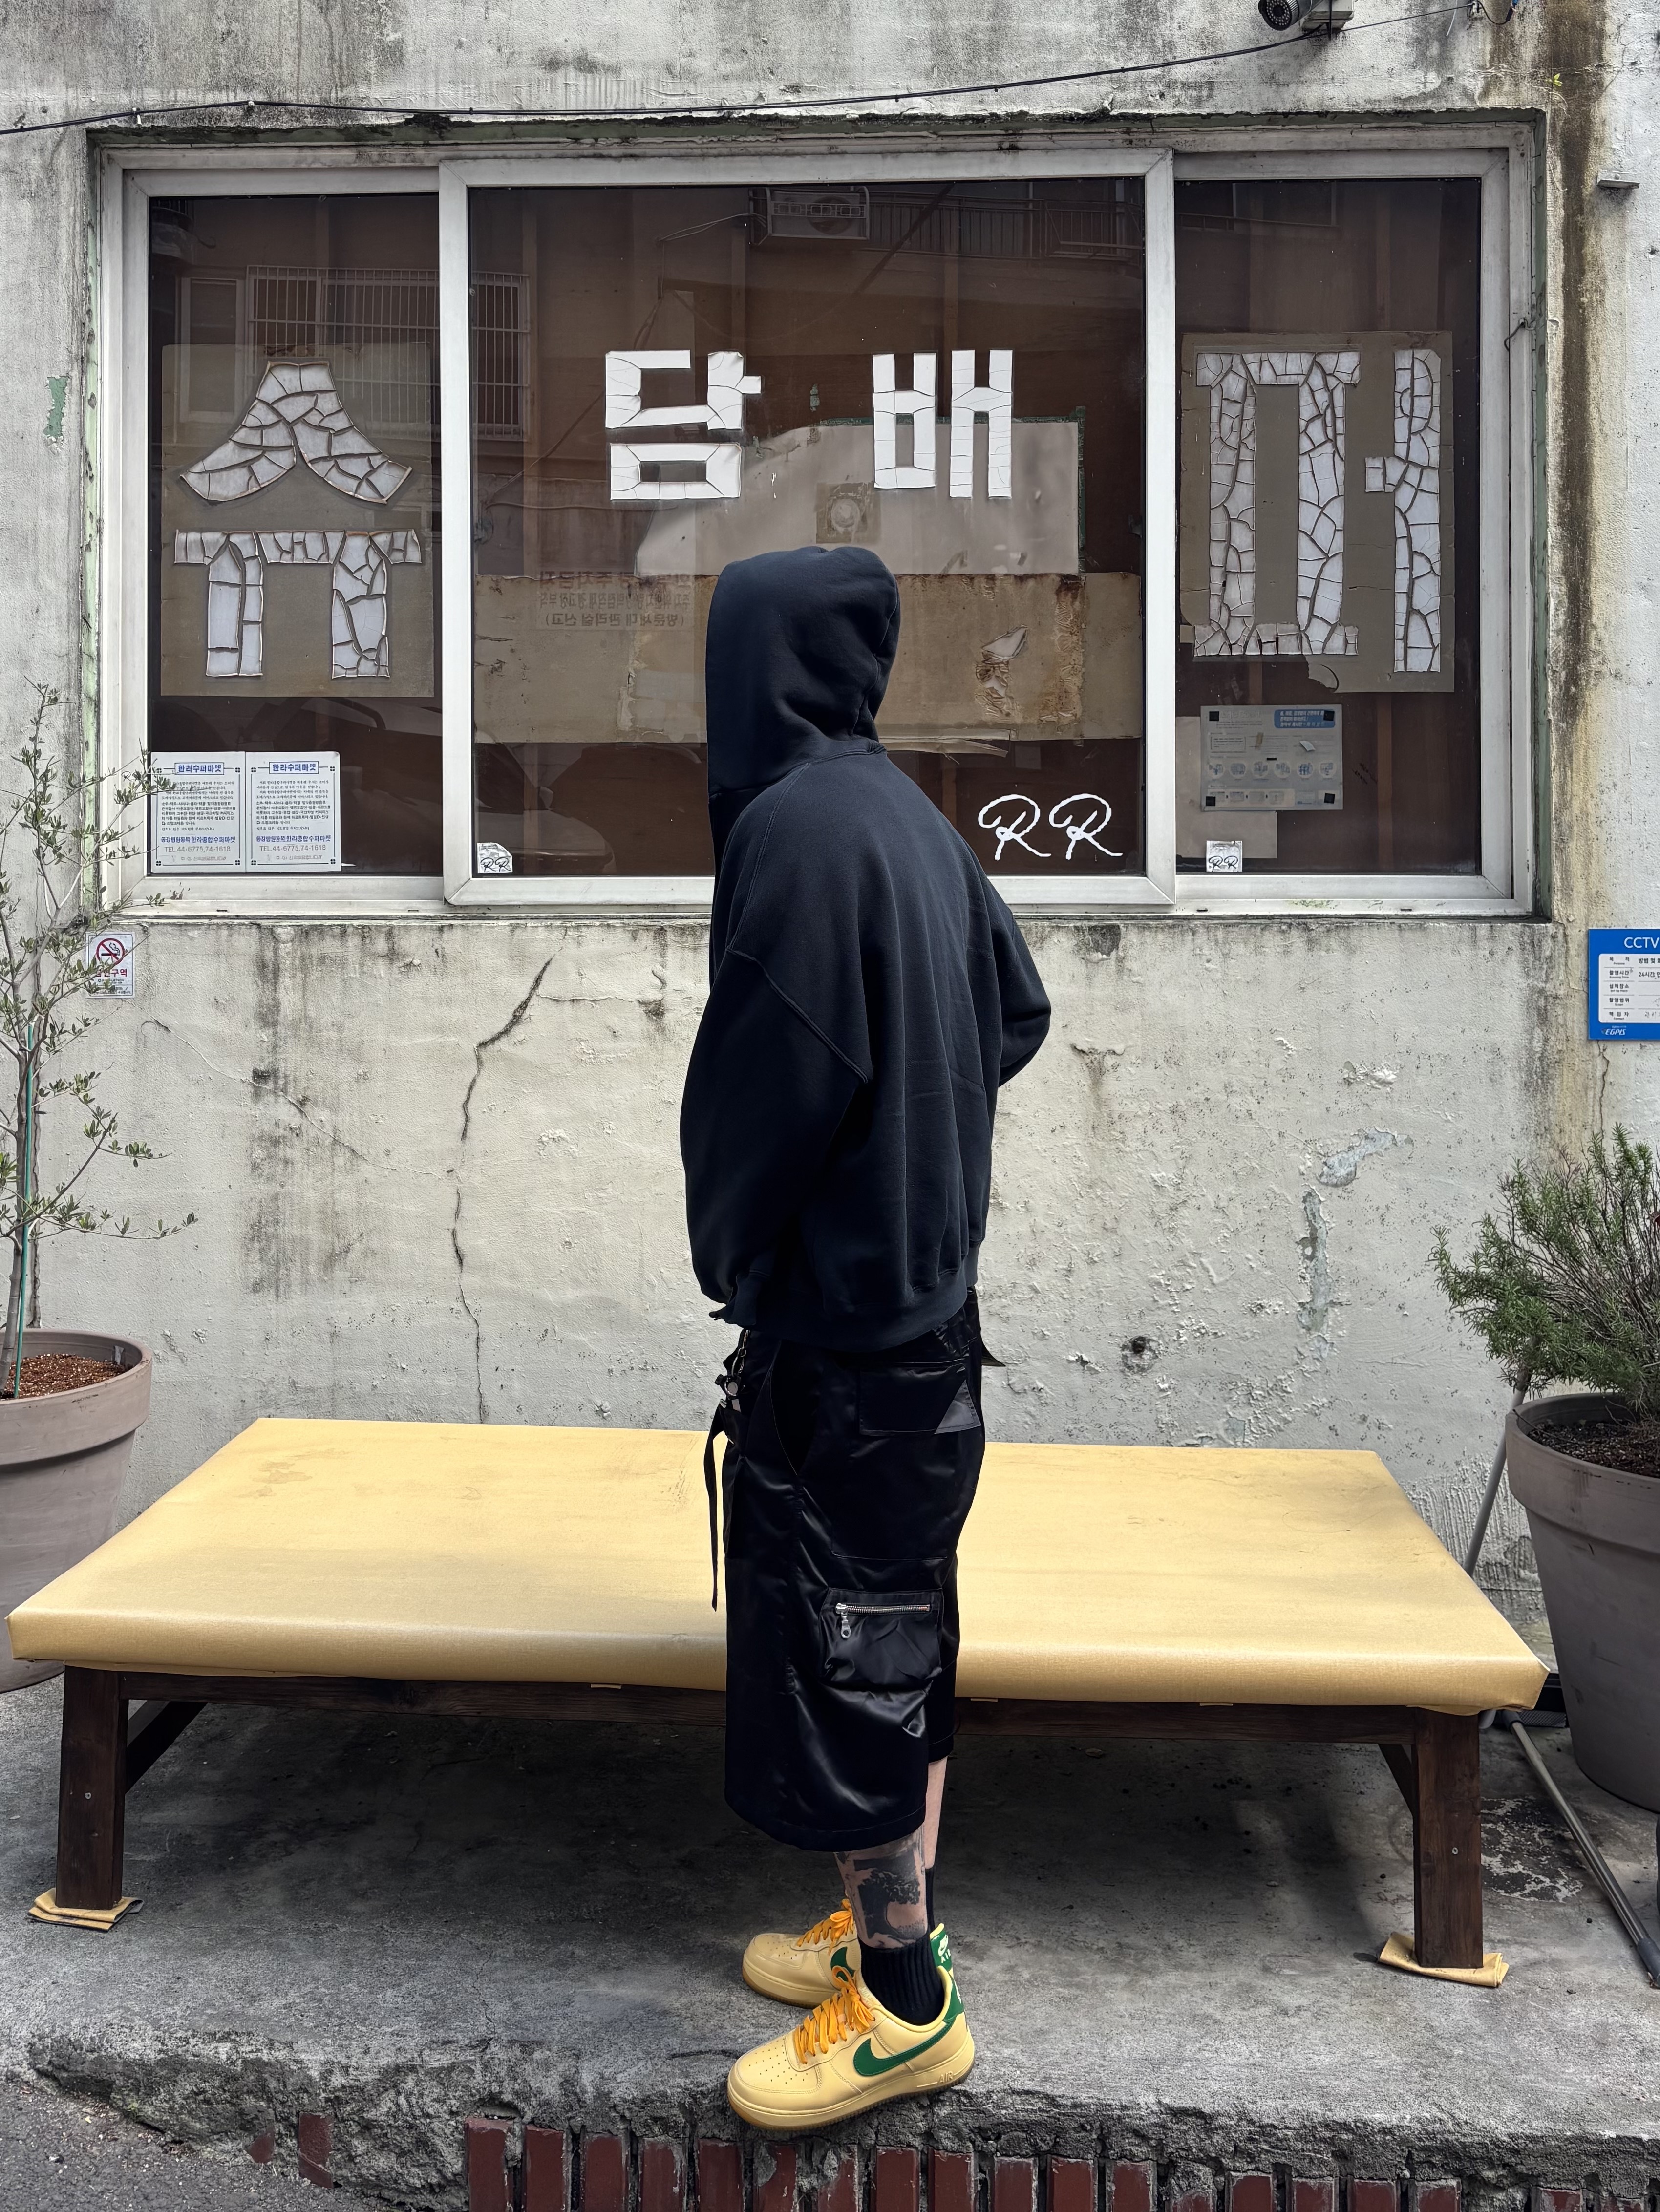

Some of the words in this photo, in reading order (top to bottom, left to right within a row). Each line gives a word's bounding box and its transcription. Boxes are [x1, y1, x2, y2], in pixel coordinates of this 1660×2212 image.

[174, 360, 422, 679] 슈
[1194, 349, 1441, 673] 퍼
[1624, 937, 1659, 949] CCTV
[938, 2071, 953, 2084] AIR
